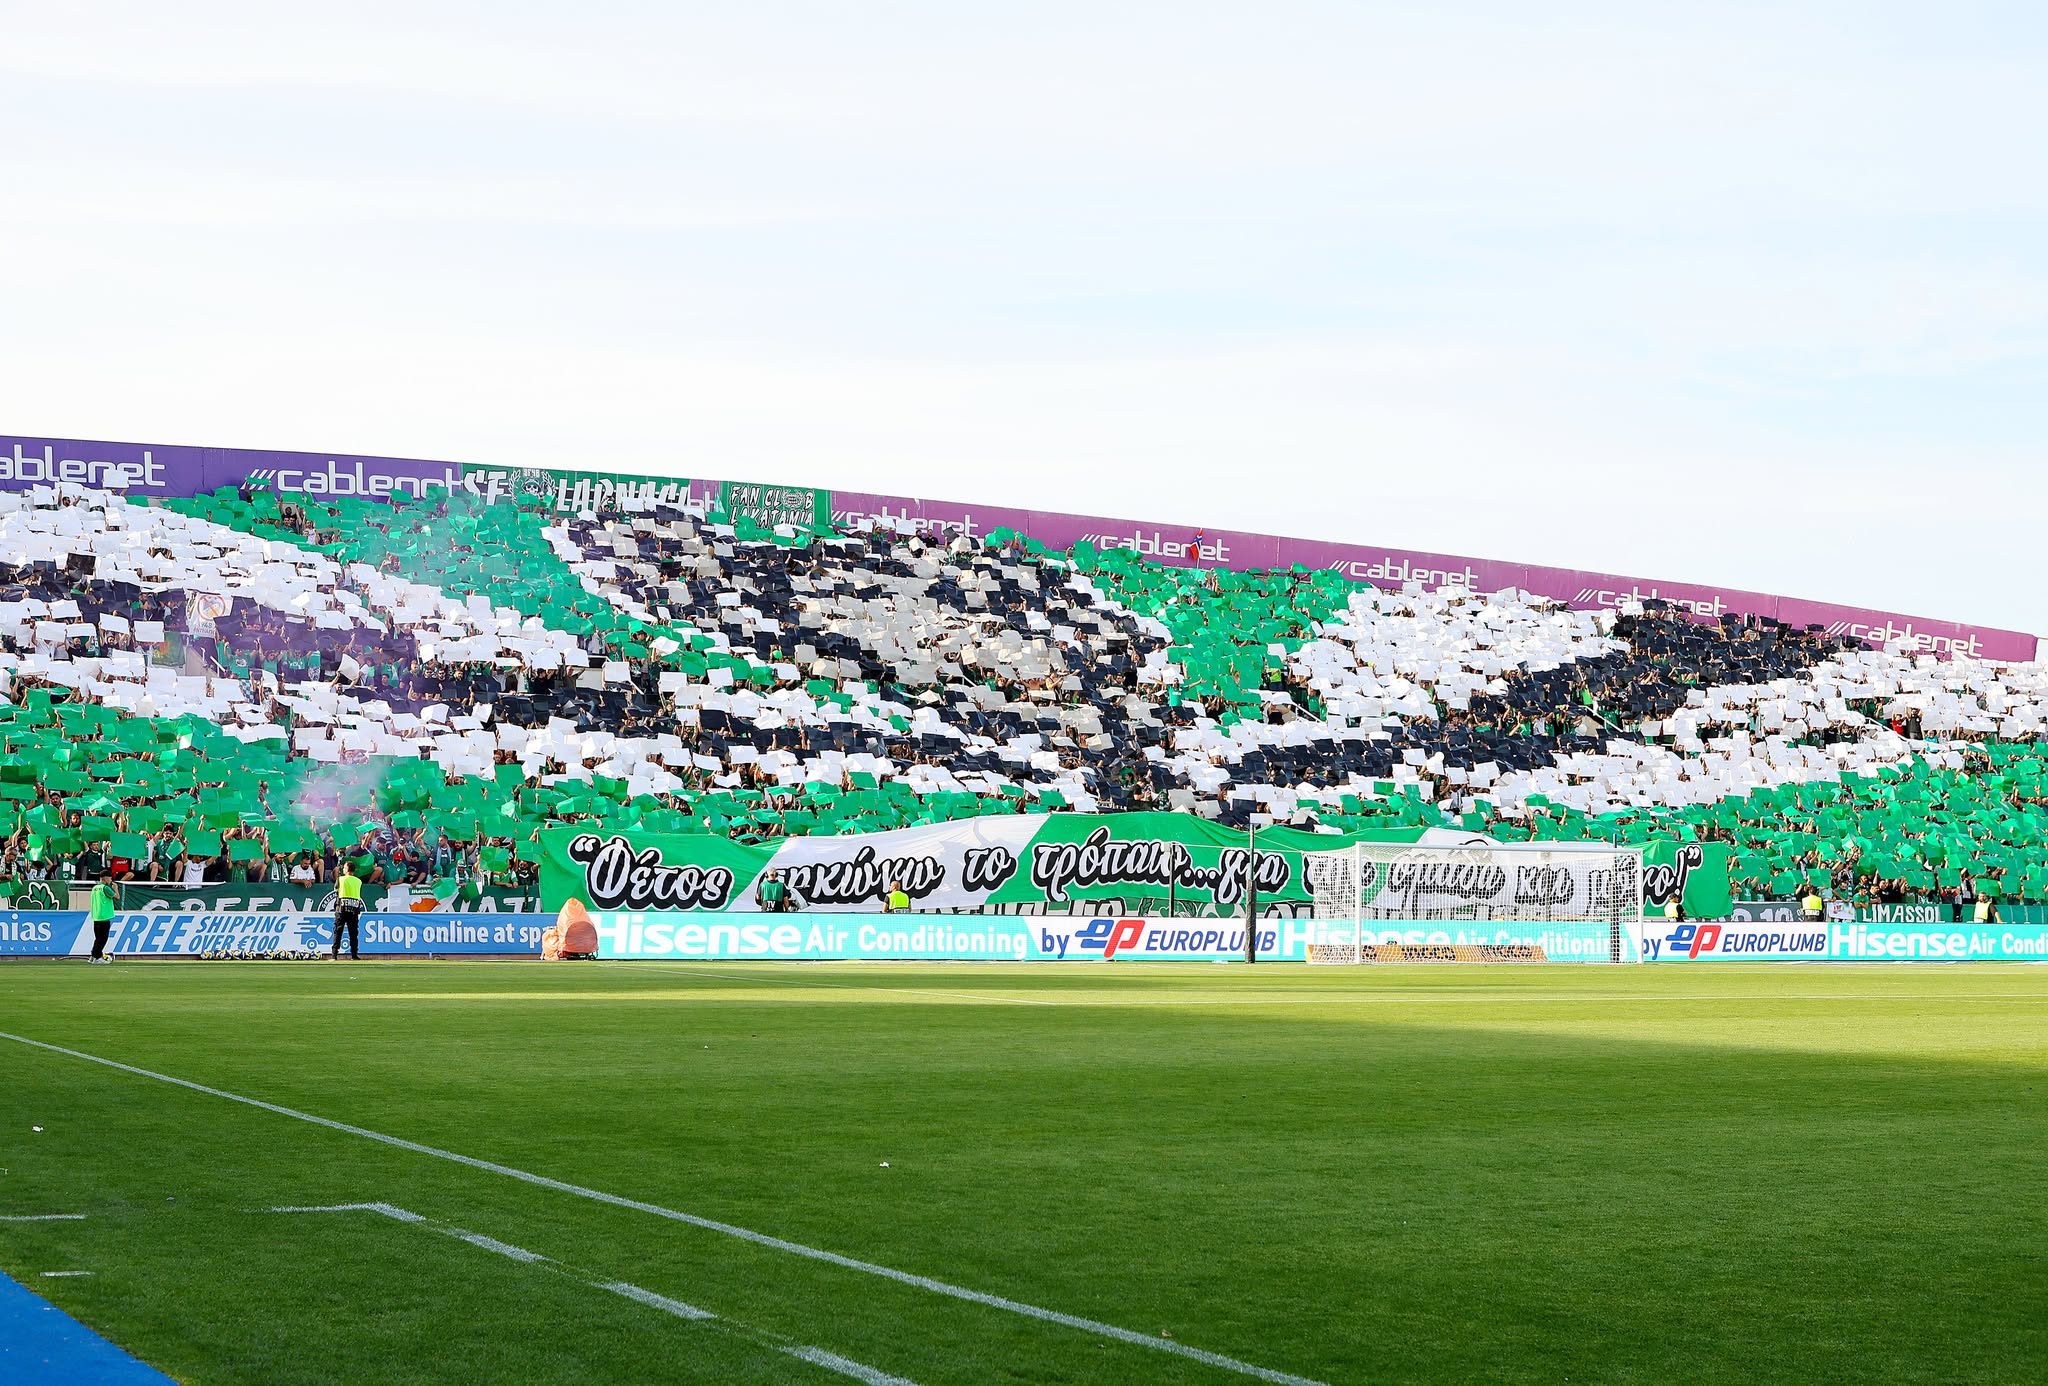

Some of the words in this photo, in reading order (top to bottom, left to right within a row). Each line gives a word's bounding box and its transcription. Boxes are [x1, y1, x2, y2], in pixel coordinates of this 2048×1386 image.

[730, 486, 761, 506] FAN
[1350, 557, 1479, 590] cablenet
[1850, 621, 1984, 657] cablenet
[963, 846, 1017, 892] το
[196, 916, 288, 934] SHIPPING
[1863, 904, 1945, 923] LIMASSOL
[188, 935, 233, 951] OVER
[238, 935, 279, 952] €100
[365, 920, 418, 948] Shop
[423, 920, 488, 944] online
[494, 923, 515, 943] at
[590, 913, 801, 956] Hisense
[804, 925, 848, 951] Air
[858, 925, 1027, 958] Conditioning
[1041, 928, 1069, 958] by
[1722, 933, 1826, 953] EUROPLUMB
[1832, 924, 1967, 957] Hisense
[1968, 933, 1996, 954] Air
